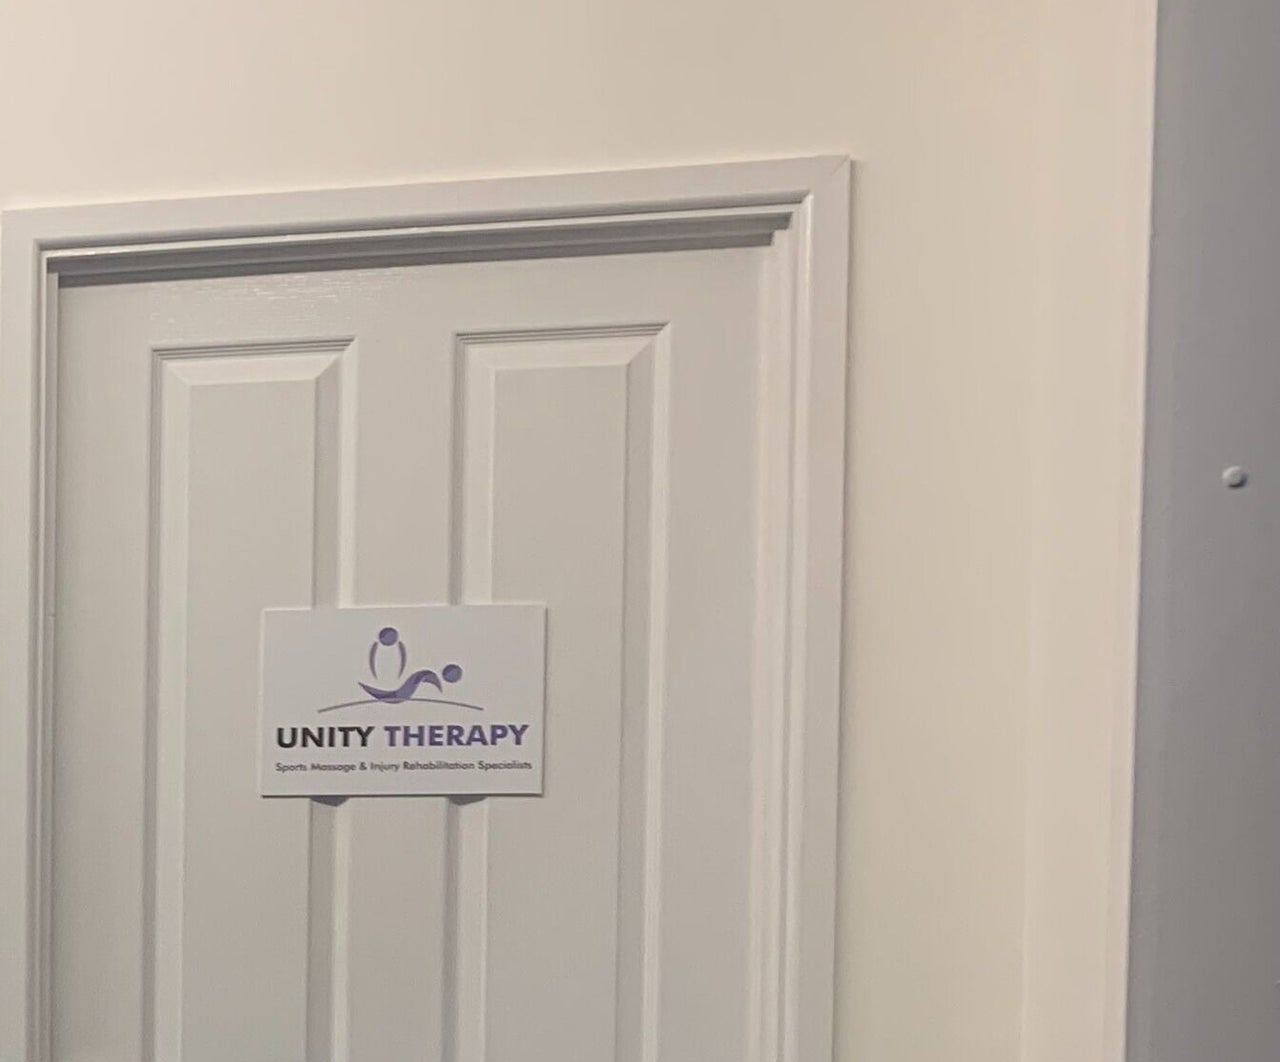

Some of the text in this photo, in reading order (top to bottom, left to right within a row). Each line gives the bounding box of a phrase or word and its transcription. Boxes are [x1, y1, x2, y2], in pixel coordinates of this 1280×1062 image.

[277, 724, 530, 748] UNITY THERAPY
[275, 760, 532, 773] Sports Massage & Injury Rehabilitation Specialists
